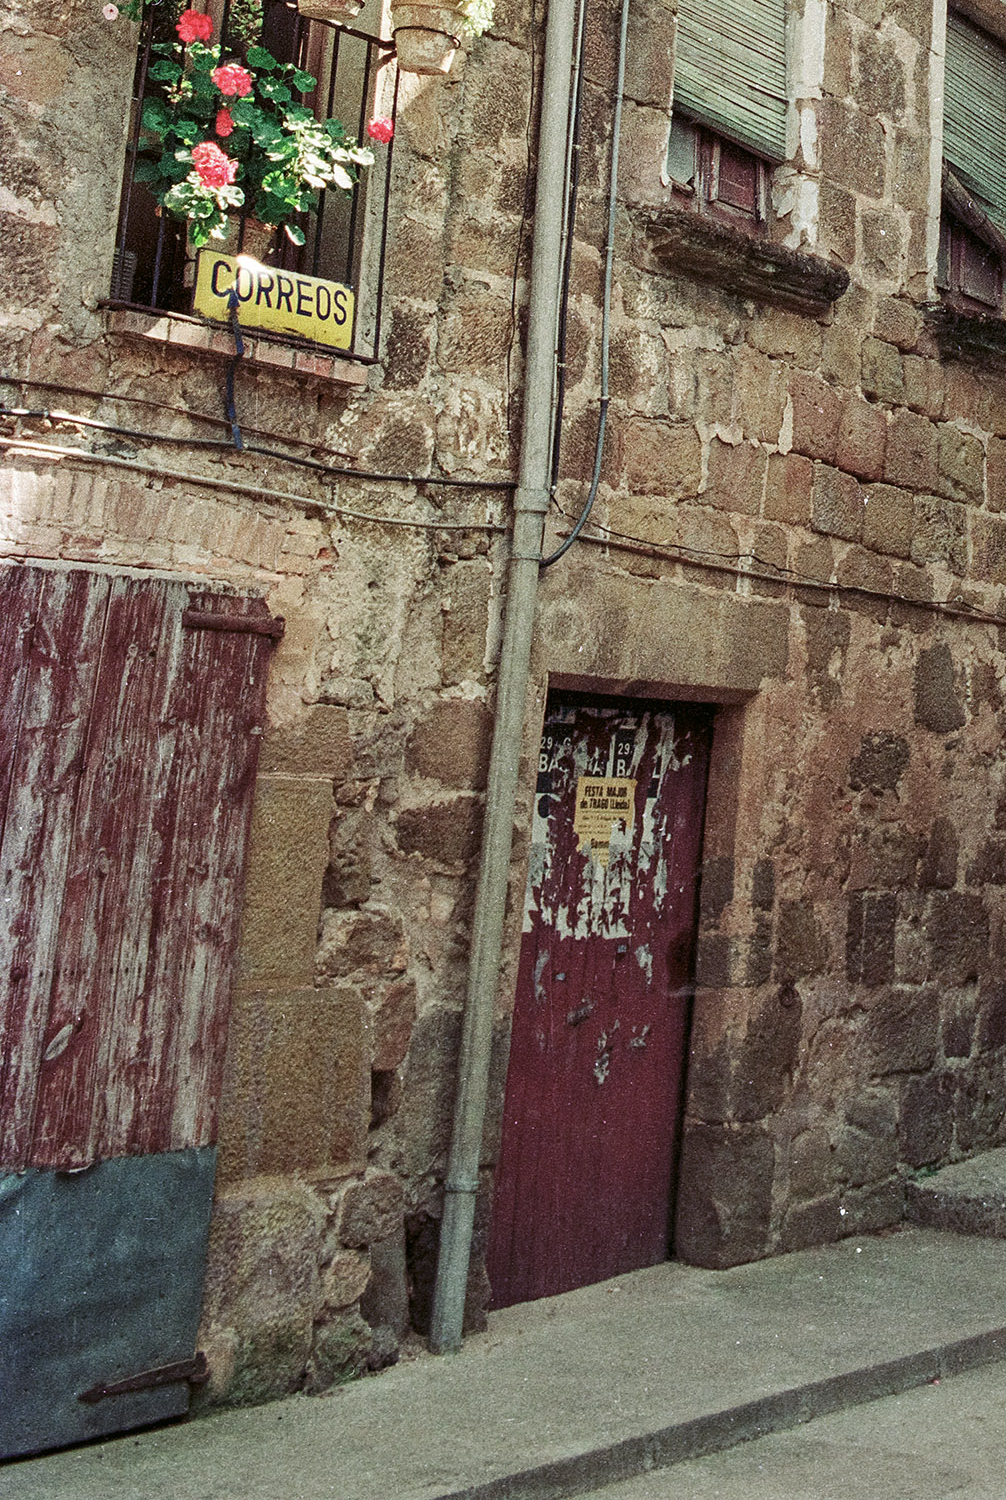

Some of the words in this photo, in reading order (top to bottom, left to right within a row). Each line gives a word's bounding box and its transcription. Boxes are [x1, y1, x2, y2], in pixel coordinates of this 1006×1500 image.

[211, 260, 347, 325] CORREOS
[585, 786, 603, 797] FESTA
[606, 786, 628, 797] MAJOR
